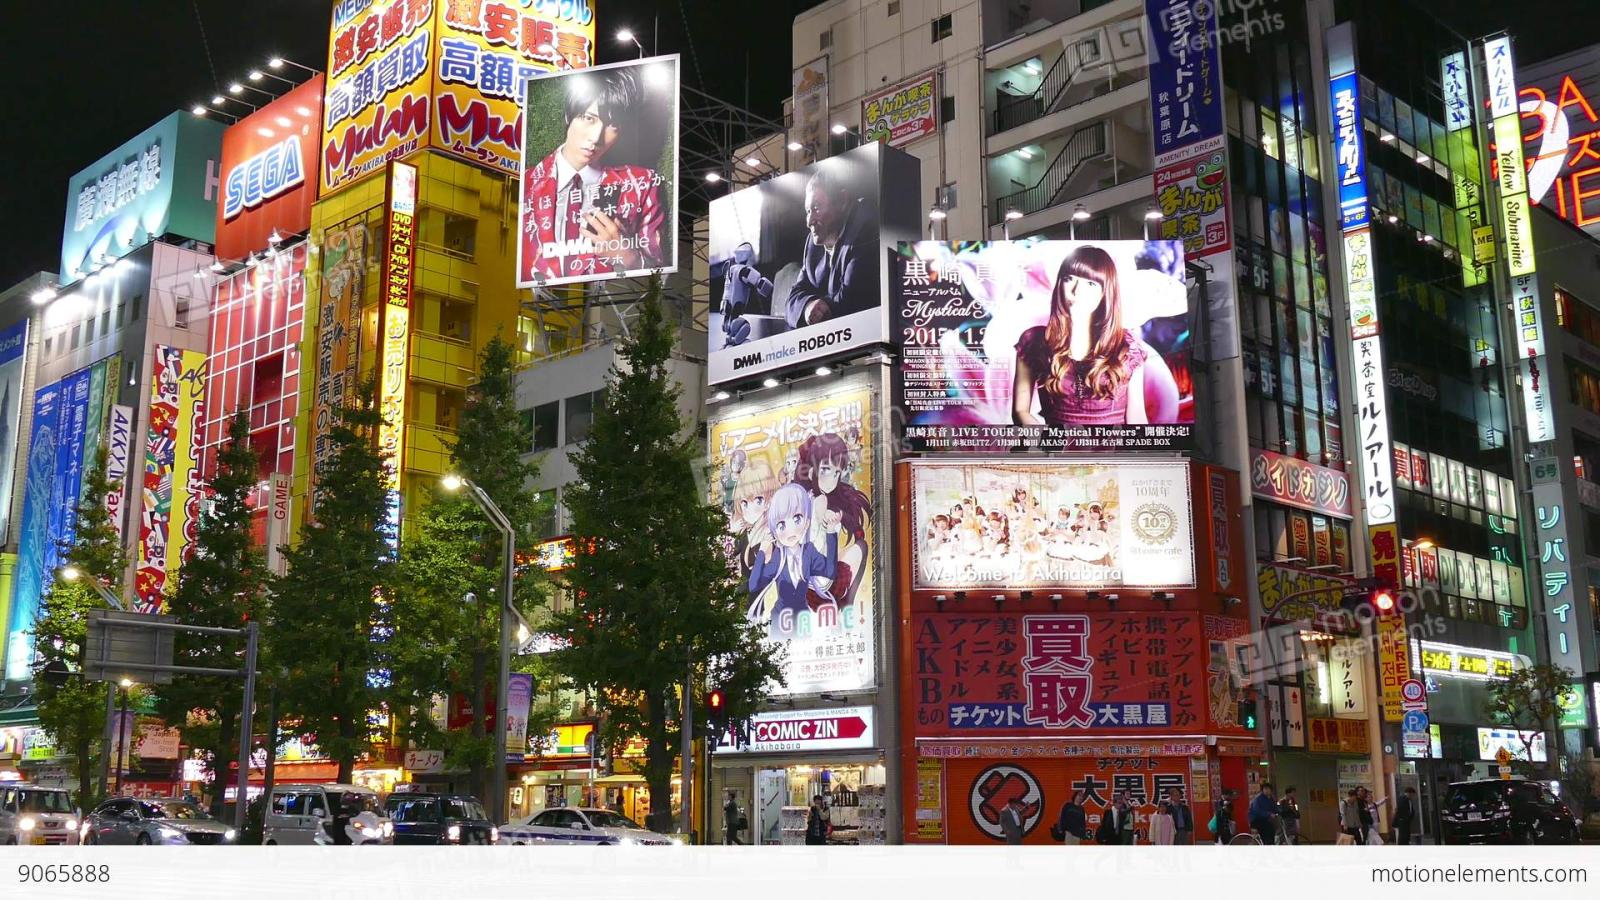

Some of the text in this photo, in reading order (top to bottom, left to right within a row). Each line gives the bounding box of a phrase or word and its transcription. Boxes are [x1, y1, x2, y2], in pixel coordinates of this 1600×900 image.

[327, 31, 429, 130] 高額買取
[866, 82, 933, 124] まんが喫茶
[1158, 91, 1173, 144] 秋葉原店
[324, 93, 429, 187] Mulan
[452, 140, 499, 162] ムーラン
[1159, 139, 1221, 165] AMENITY DREAM
[225, 135, 305, 219] SEGA
[333, 165, 362, 188] ムーラン
[362, 157, 384, 174] AKIBA
[393, 212, 412, 225] DVD
[1158, 185, 1224, 218] まんが
[1498, 148, 1524, 268] Yellow Submarine
[393, 244, 408, 256] CD
[543, 233, 651, 259] DMM mobile
[569, 255, 625, 272] のスマホ
[903, 287, 962, 298] ニューアルバム
[1516, 275, 1531, 287] 5F
[902, 298, 973, 327] Mystical
[798, 327, 853, 353] ROBOTS
[111, 409, 129, 470] AKKY
[906, 427, 948, 438] 黒崎真音
[951, 428, 979, 437] LIVE
[982, 428, 1015, 437] TOUR
[1018, 428, 1040, 437] 2016
[1145, 426, 1190, 437] 開催決定!
[1102, 438, 1124, 447] 名古屋
[1126, 438, 1152, 447] SPADE
[1154, 438, 1171, 447] BOX
[1253, 454, 1349, 512] メイドカジノ
[1394, 447, 1428, 487] 買取
[1534, 463, 1558, 479] 6号
[274, 479, 289, 520] GAME
[922, 562, 1122, 582] Welcome to Akihabara
[1402, 545, 1438, 583] 買取
[1538, 505, 1570, 654] リバティー
[778, 600, 867, 638] GAME!
[814, 642, 867, 658] 得能正太郎
[947, 617, 969, 698] アイドル
[971, 617, 993, 678] アニメ
[995, 617, 1020, 700] 美少女系
[1097, 617, 1121, 700] フィギュア
[1120, 617, 1142, 678] ホビー
[1145, 617, 1170, 700] 携帯電話
[1022, 614, 1097, 729] 買取
[1171, 616, 1197, 727] アップルとか
[1340, 659, 1357, 711] ルノアール
[1406, 686, 1420, 697] 40
[757, 718, 839, 742] COMIC ZIN
[950, 704, 1168, 727] チケット 大黒屋
[408, 753, 440, 768] ラーメン
[755, 742, 801, 753] Akihabara
[1097, 757, 1159, 771] チケット
[1071, 773, 1188, 809] 大黒屋
